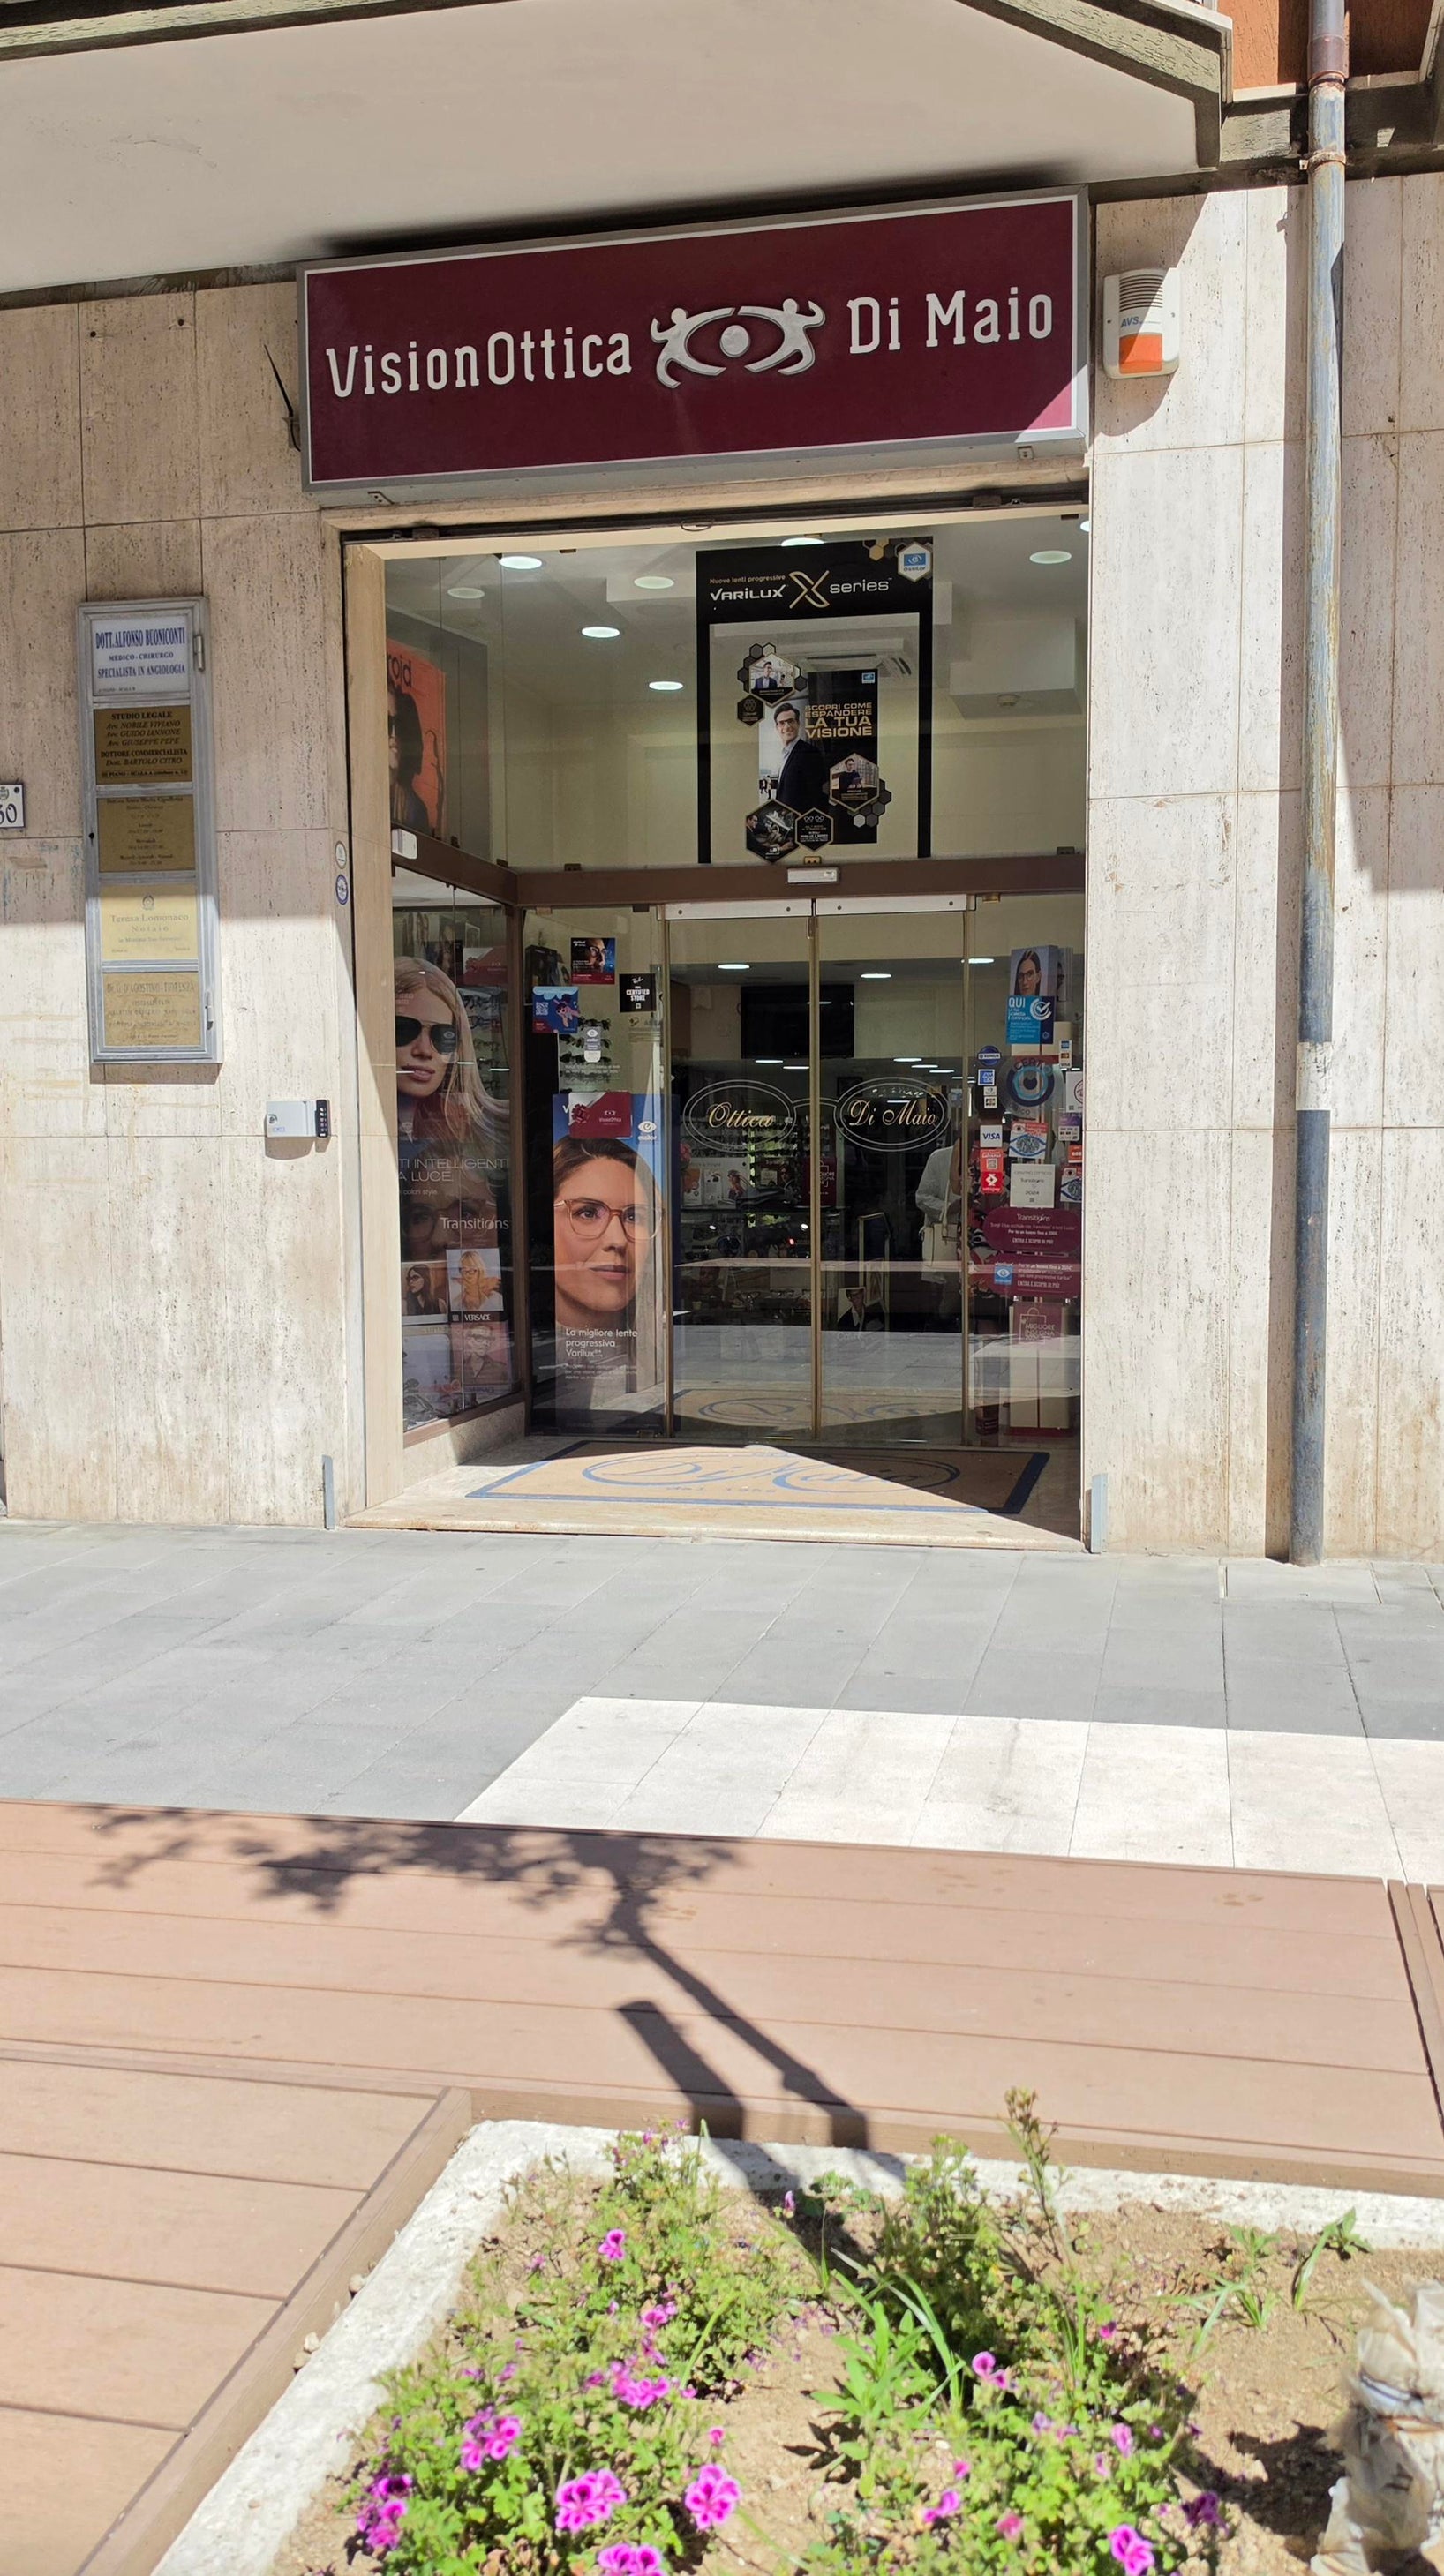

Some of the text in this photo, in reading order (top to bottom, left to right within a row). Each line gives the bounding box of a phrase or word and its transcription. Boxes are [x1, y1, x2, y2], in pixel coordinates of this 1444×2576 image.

[1120, 316, 1139, 328] AVS
[326, 286, 1053, 398] VisionOttica Di Maio
[748, 574, 786, 584] progressive
[97, 664, 185, 679] SPECIALISTA IN ANGIOLOGIA
[141, 710, 173, 719] LEGALE
[804, 709, 872, 718] ESPANDERE
[805, 715, 872, 728] LA TUA
[805, 726, 872, 739] VISIONE
[1008, 996, 1026, 1009] QUI
[708, 1099, 937, 1128] Ottica Di Maio
[414, 1158, 509, 1169] INTELLIGENTI
[411, 1171, 455, 1183] LUCE
[440, 1214, 509, 1231] Transitions
[578, 1328, 613, 1339] migliore
[615, 1328, 638, 1338] lente
[566, 1339, 615, 1349] progressiva
